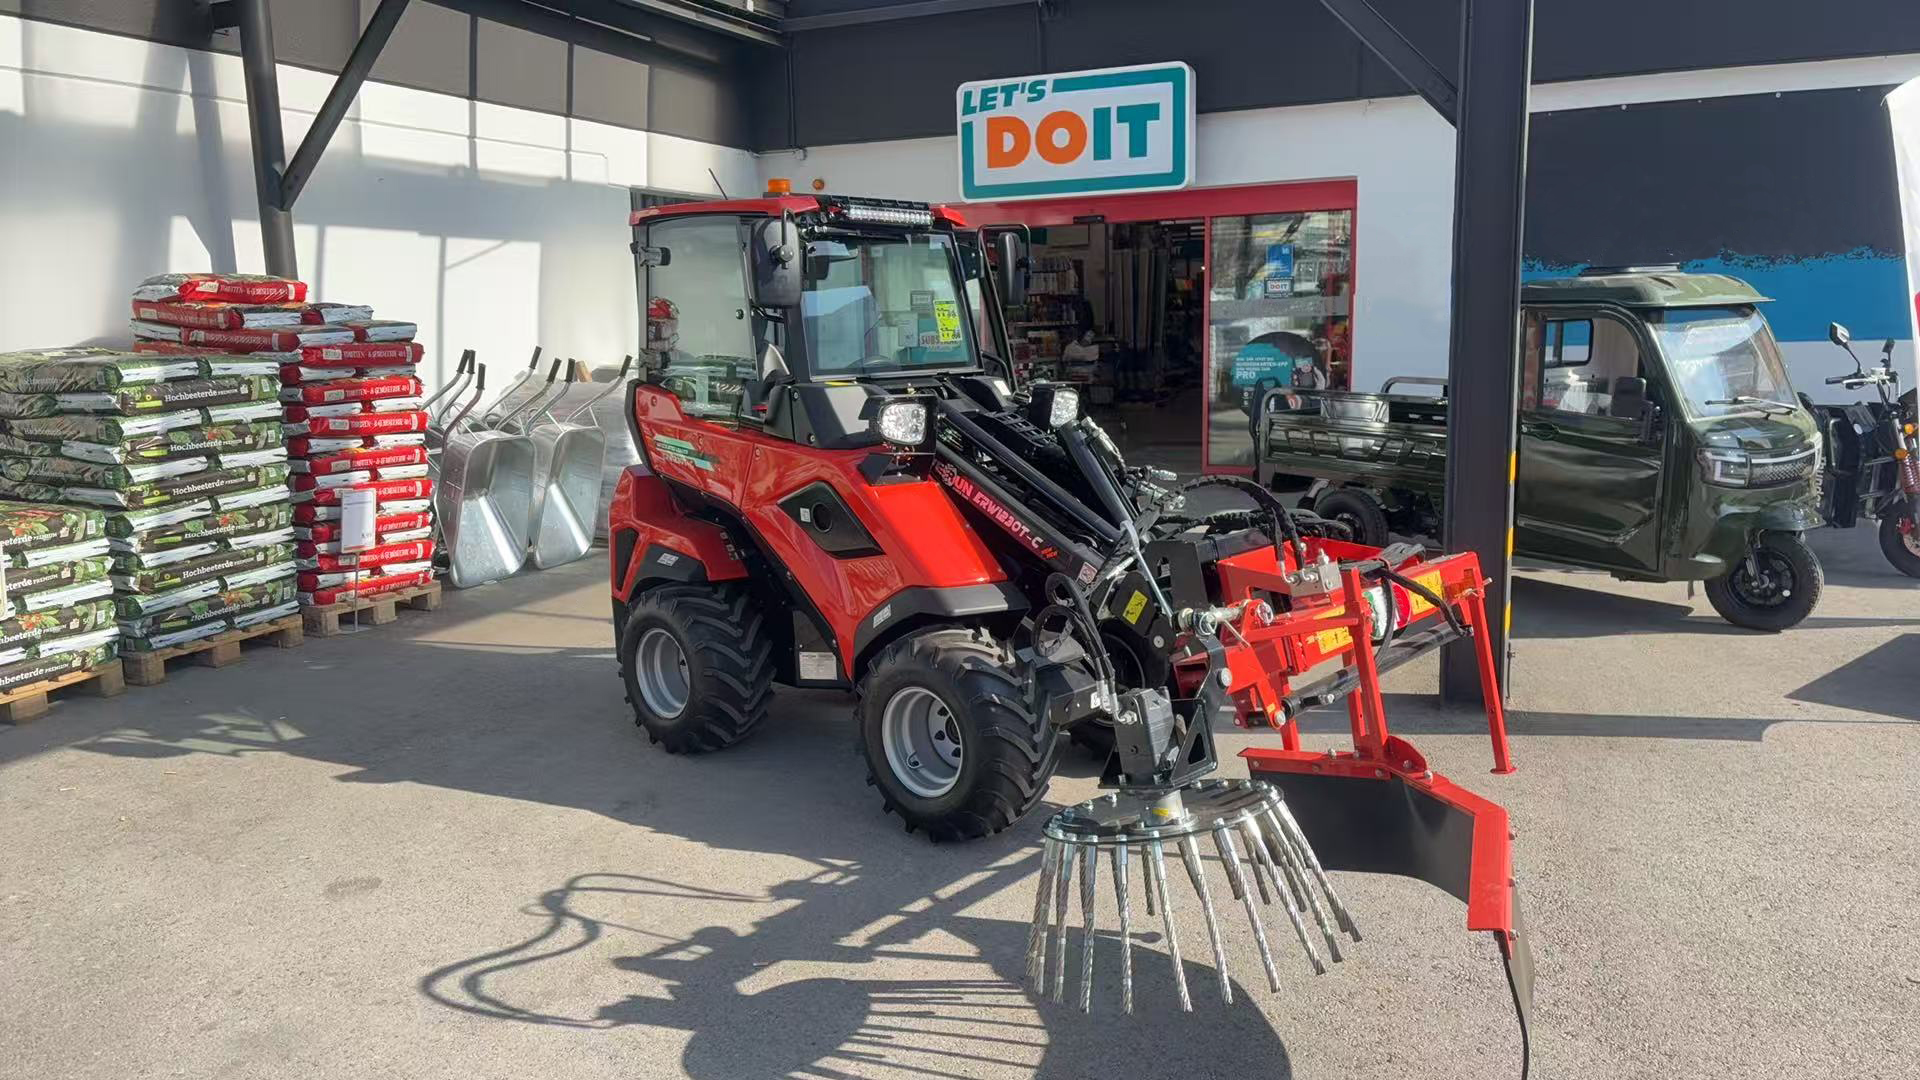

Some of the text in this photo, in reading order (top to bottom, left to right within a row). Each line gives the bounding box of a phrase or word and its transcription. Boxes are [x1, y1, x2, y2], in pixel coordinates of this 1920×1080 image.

[962, 80, 1048, 116] LET'S
[1236, 371, 1256, 379] PRO
[164, 389, 218, 403] Hochbeeterde
[170, 439, 222, 452] Hochbeeterde
[172, 479, 225, 496] Hochbeeterde
[182, 560, 234, 579] Hochbeeterde
